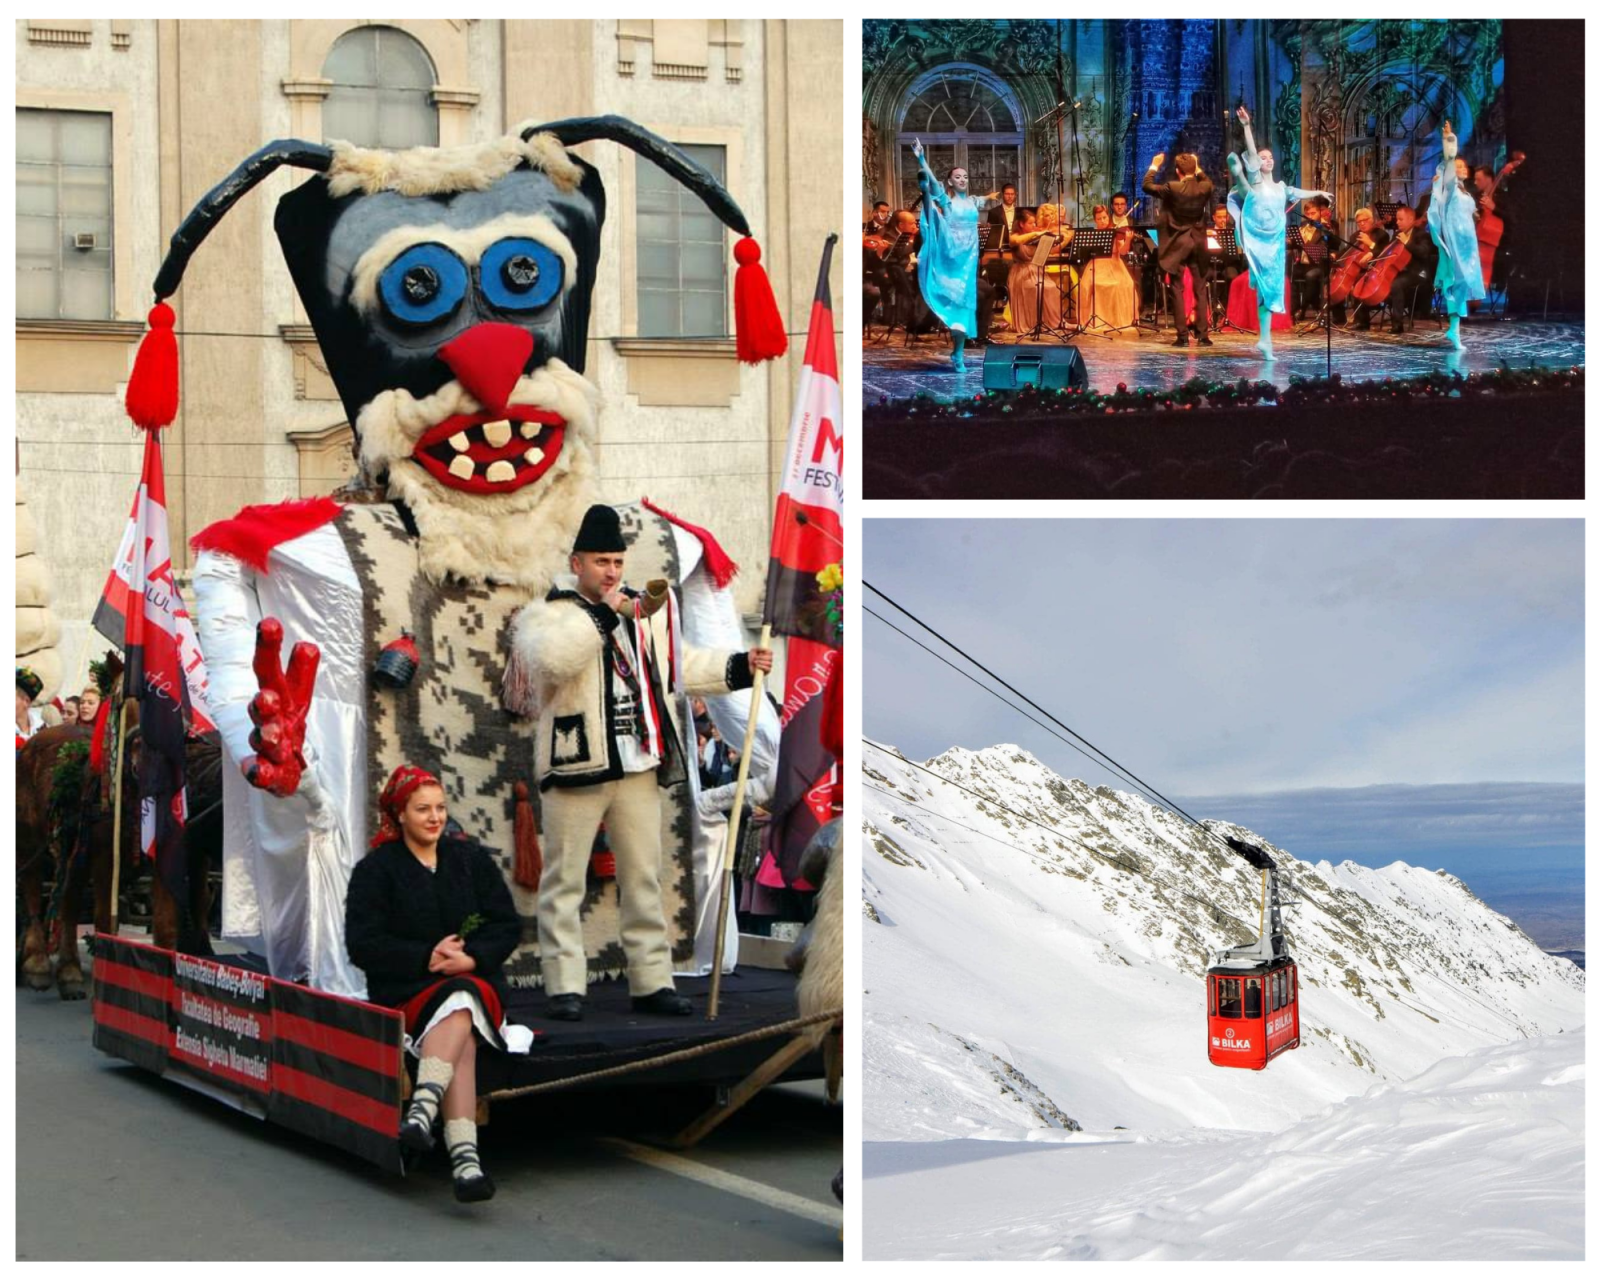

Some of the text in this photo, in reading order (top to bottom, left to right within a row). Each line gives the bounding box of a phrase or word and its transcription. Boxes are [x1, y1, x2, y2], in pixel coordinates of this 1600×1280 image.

[212, 1002, 222, 1027] de
[223, 1005, 260, 1041] Geografie
[1274, 1012, 1293, 1031] BILKA
[1221, 1038, 1251, 1049] BILKA
